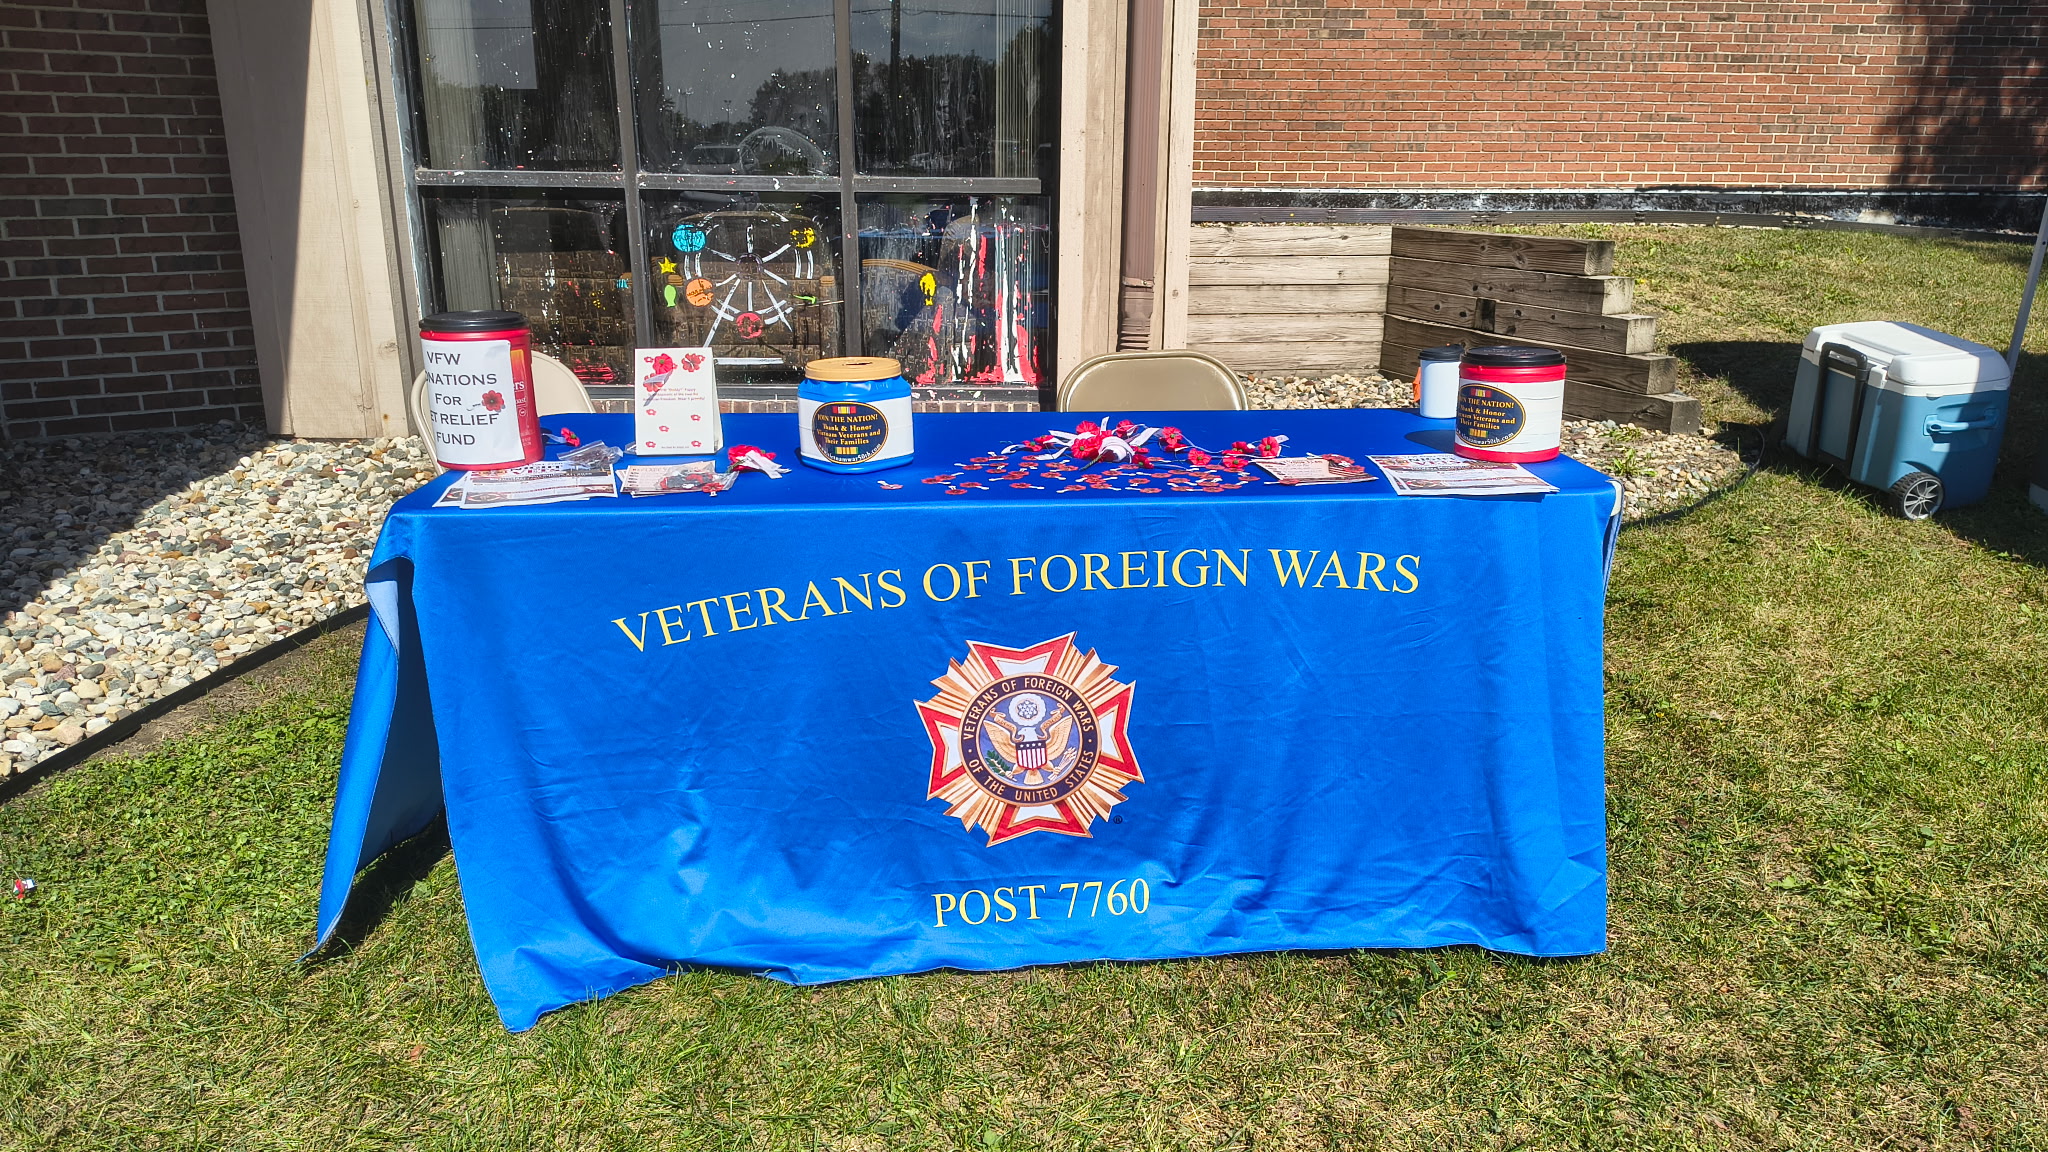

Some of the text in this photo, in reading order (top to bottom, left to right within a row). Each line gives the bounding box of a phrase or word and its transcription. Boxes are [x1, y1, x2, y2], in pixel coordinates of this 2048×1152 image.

[427, 351, 461, 365] VFW
[435, 393, 462, 405] FOR
[1482, 400, 1514, 408] NATION!
[847, 414, 878, 422] NATION!
[1473, 414, 1500, 423] Veterans
[1483, 408, 1506, 417] Honor
[440, 413, 499, 426] RELIEF
[1474, 421, 1500, 430] Families
[823, 423, 839, 431] Thank
[436, 431, 476, 446] FUND
[611, 549, 1421, 653] VETERANS OF FOREIGN WARS
[963, 688, 998, 740] VETERANS
[1001, 680, 1017, 693] OF
[1024, 677, 1073, 701] FOREIGN
[1073, 700, 1094, 732] WARS
[969, 750, 1094, 802] OF THE UNITED STATES
[931, 878, 1150, 928] POST 7760
